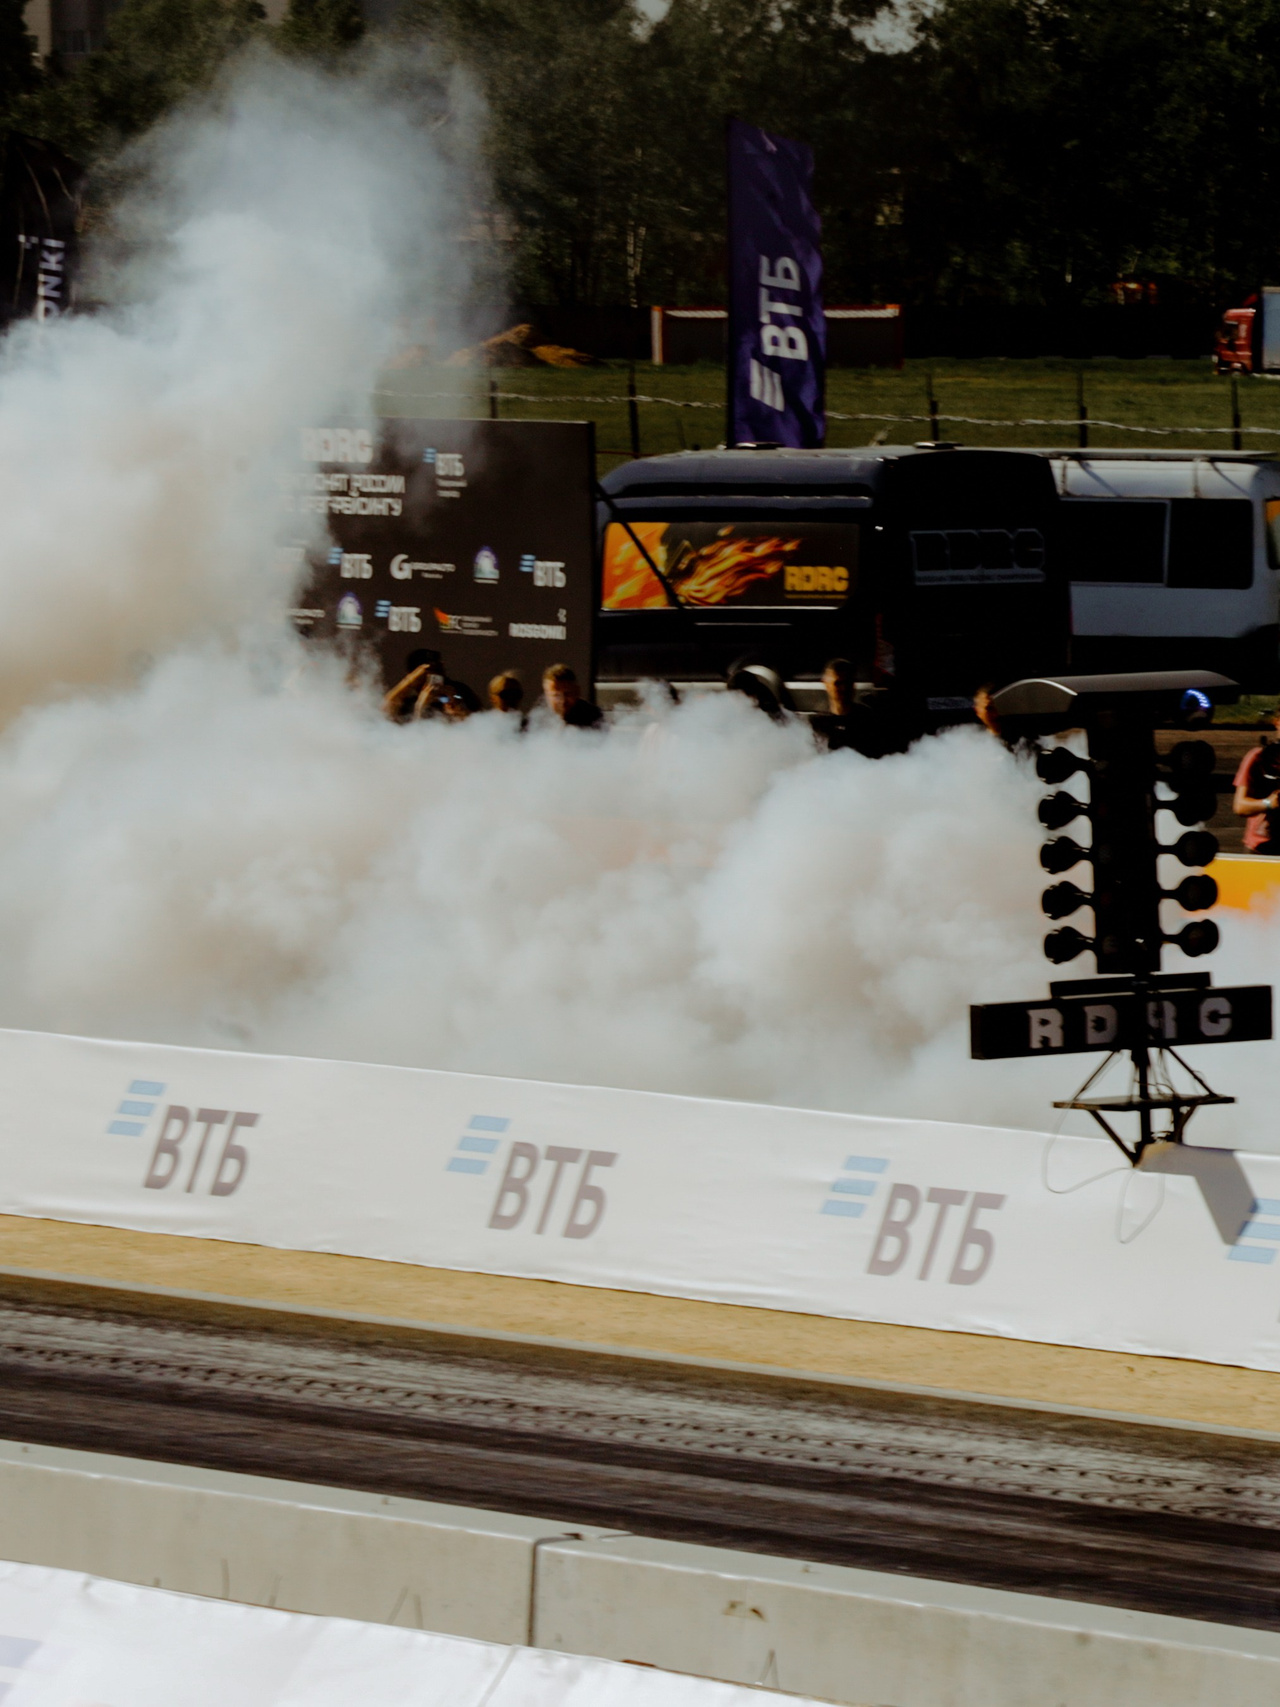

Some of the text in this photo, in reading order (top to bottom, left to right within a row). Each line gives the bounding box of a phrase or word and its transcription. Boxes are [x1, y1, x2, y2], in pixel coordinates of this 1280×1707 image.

[759, 254, 809, 362] ВТБ
[340, 553, 374, 579] ВТБ
[534, 560, 567, 588] ВТБ
[783, 566, 850, 592] RDRC
[388, 606, 422, 632] ВТБ
[143, 1105, 263, 1197] ВТБ
[488, 1140, 620, 1240] ВТБ
[867, 1182, 1008, 1286] ВТБ
